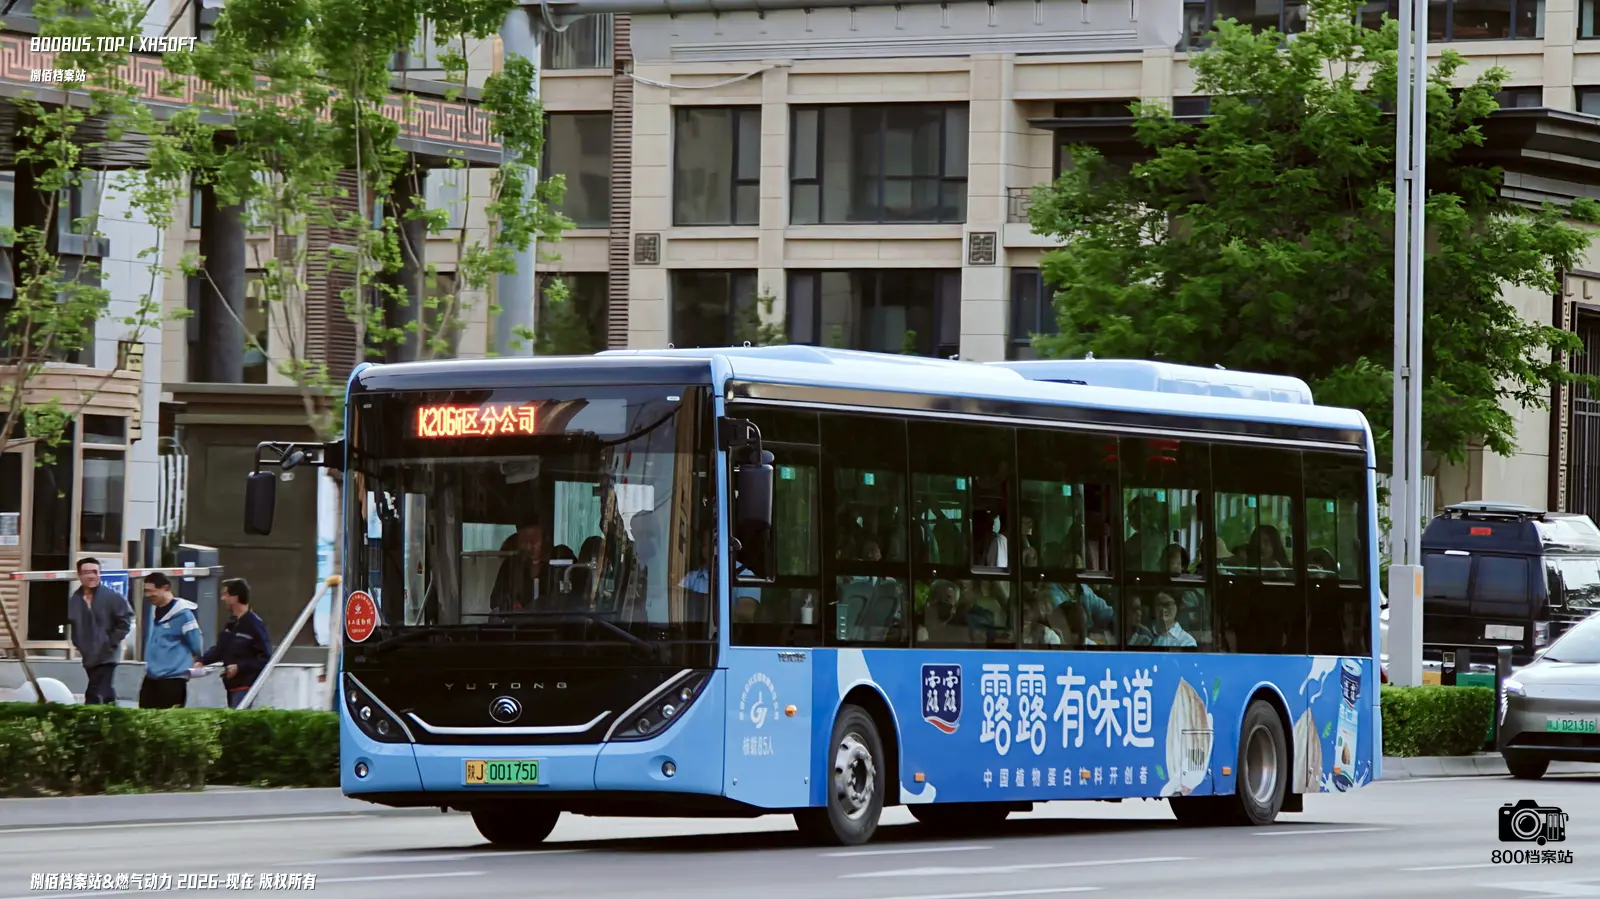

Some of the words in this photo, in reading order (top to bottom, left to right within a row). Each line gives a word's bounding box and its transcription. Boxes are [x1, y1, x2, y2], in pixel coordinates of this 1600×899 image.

[444, 682, 568, 691] YUTONG
[980, 663, 1155, 756] 露露有味道
